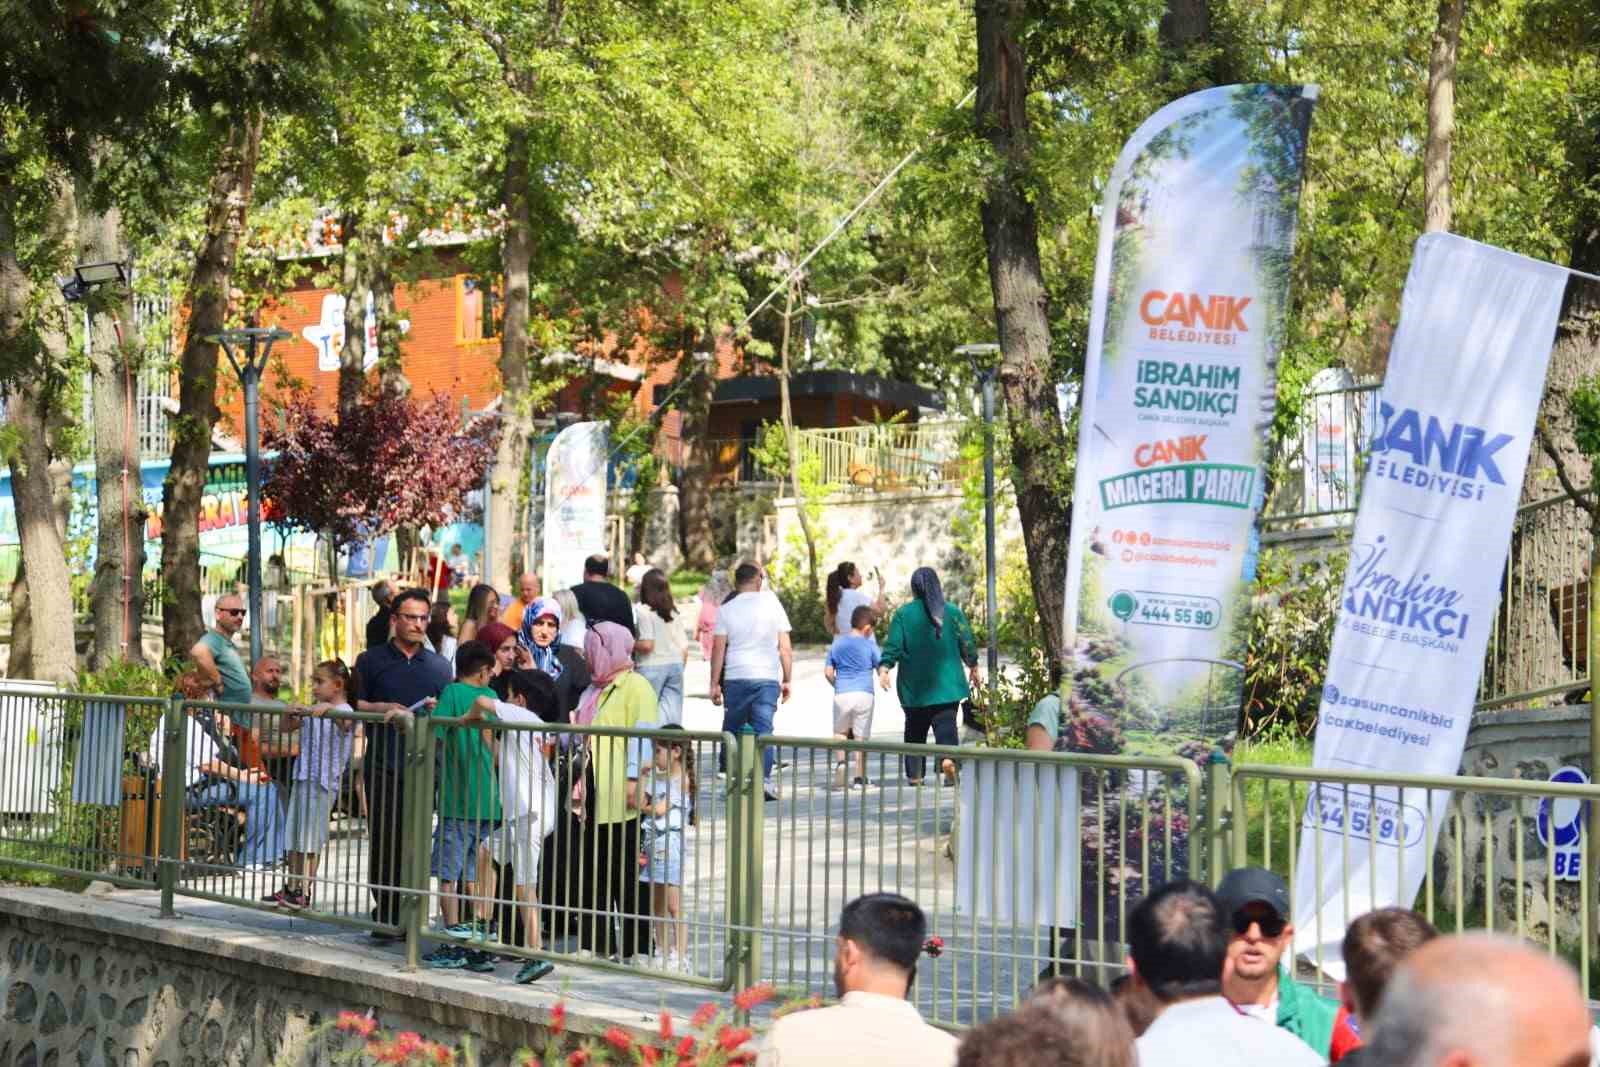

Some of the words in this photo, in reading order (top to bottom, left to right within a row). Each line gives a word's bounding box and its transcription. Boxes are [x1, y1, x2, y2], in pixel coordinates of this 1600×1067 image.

[1139, 290, 1252, 332] CANİK
[1137, 359, 1241, 390] İBRAHİM
[1133, 386, 1239, 417] SANDIKÇI
[1104, 469, 1187, 506] MACERA
[1192, 468, 1251, 504] PARKI
[1141, 604, 1171, 622] 444
[1174, 607, 1191, 624] 55
[1195, 609, 1213, 626] 90
[1343, 590, 1469, 639] ANDIKÇI
